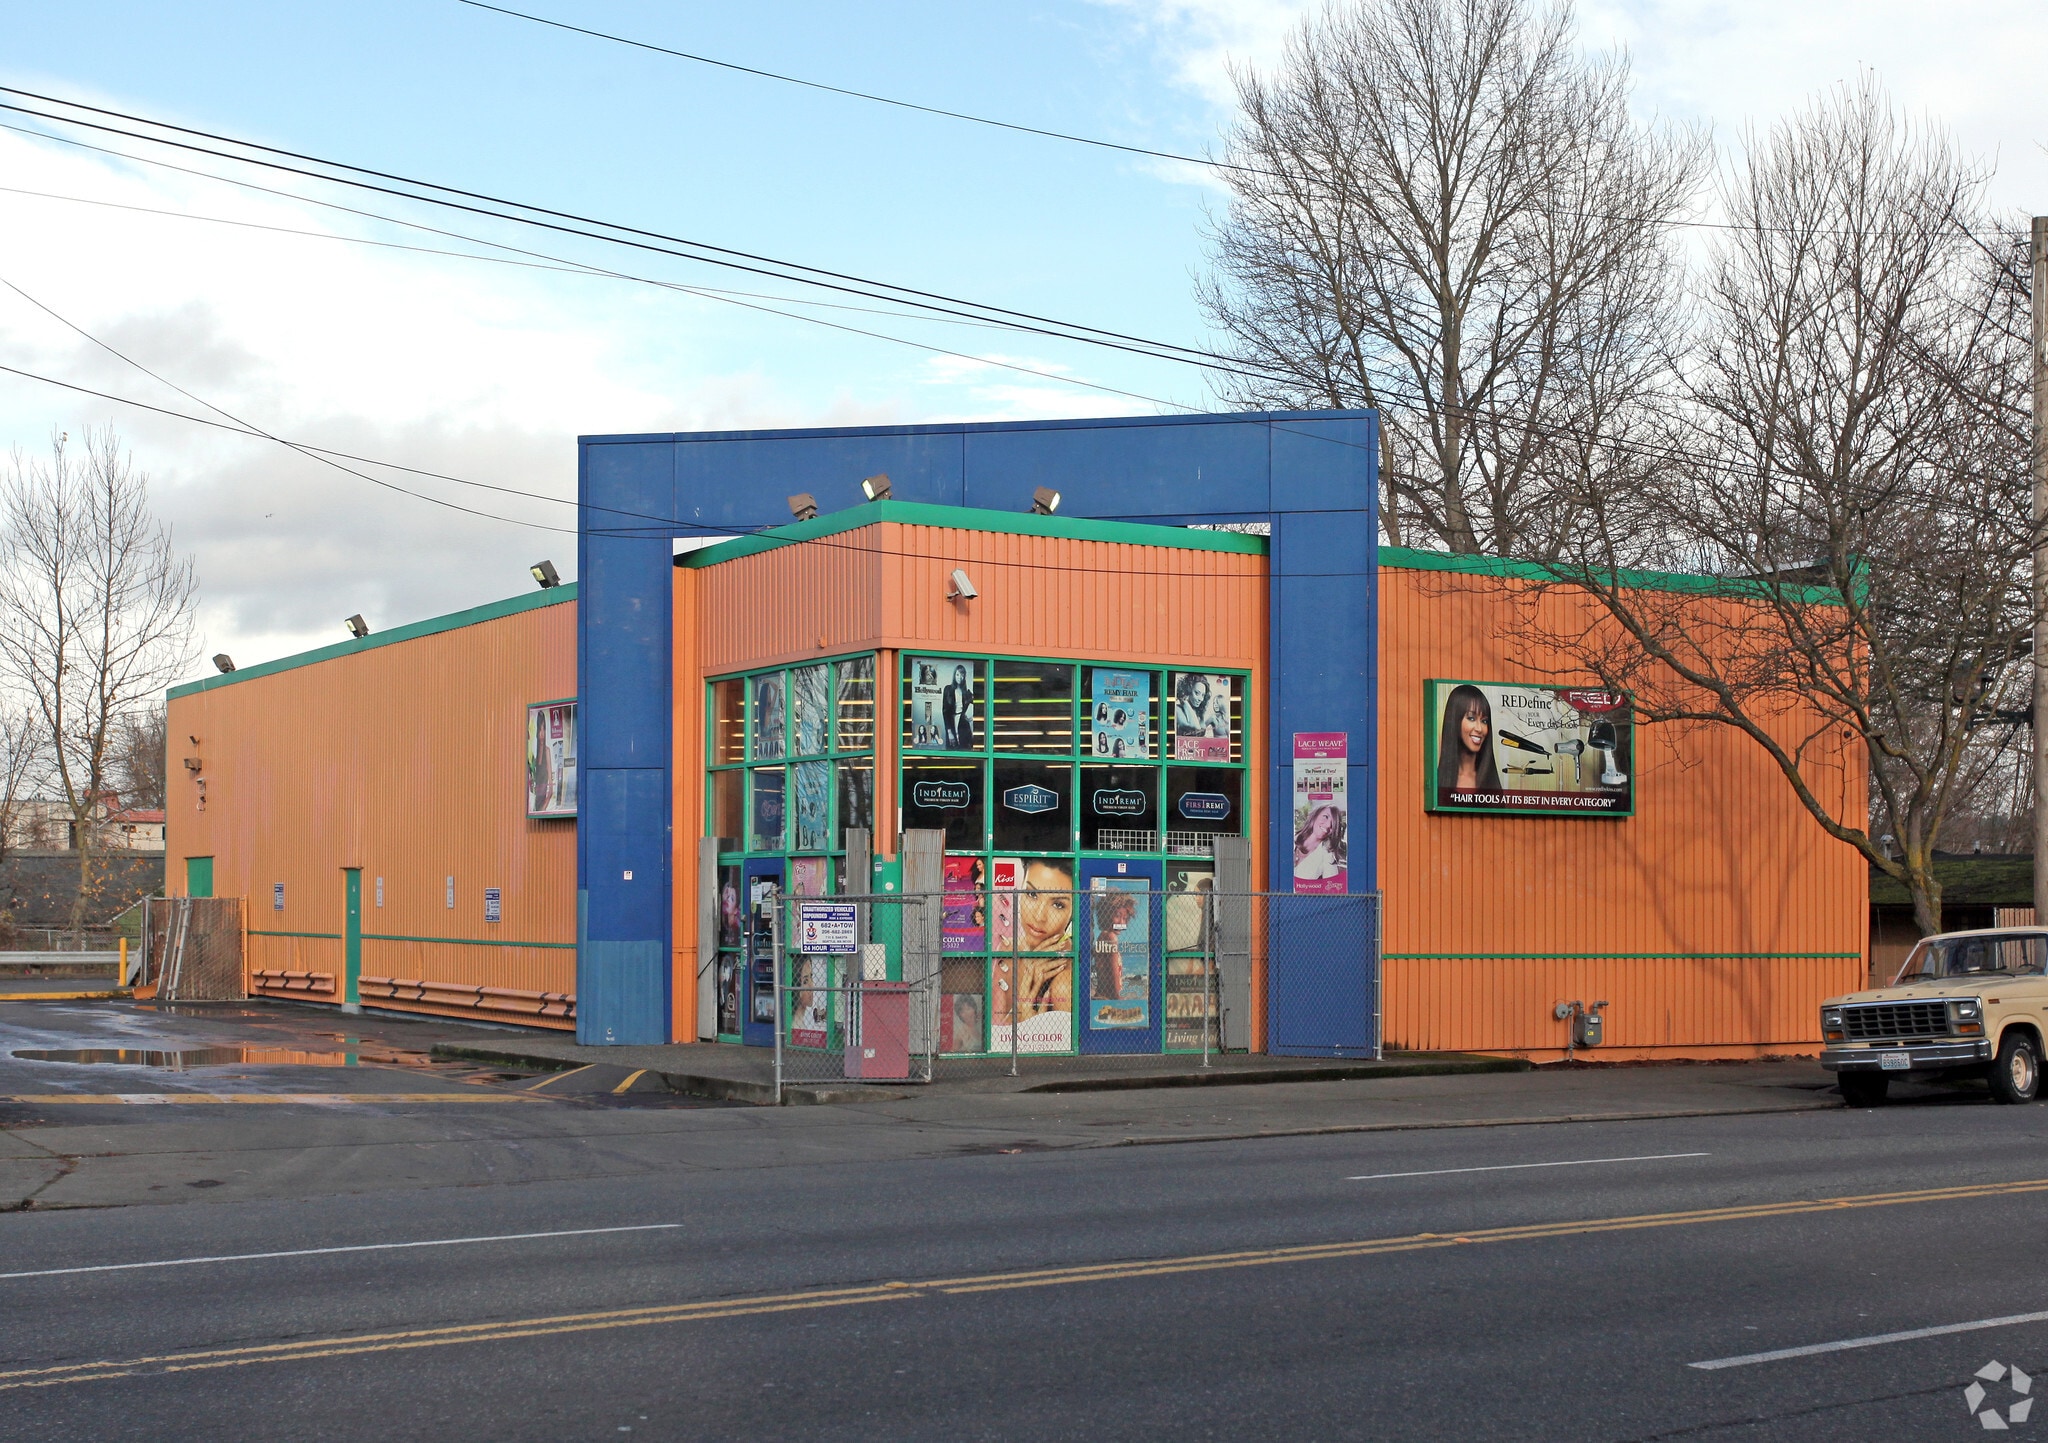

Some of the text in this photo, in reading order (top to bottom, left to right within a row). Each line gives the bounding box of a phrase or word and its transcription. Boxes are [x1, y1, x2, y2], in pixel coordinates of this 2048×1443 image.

[1501, 694, 1552, 709] REDefine
[1178, 740, 1200, 749] LACE
[1014, 792, 1048, 804] ESPIRIT
[1474, 794, 1500, 804] TOOLS
[1500, 795, 1511, 804] AT
[1512, 795, 1522, 804] ITS
[1524, 795, 1540, 805] BEST
[1541, 796, 1550, 805] IN
[1551, 797, 1573, 806] EVERY
[994, 873, 1014, 884] Kiss
[1095, 941, 1119, 954] Ultra
[1000, 1033, 1063, 1042] LIVNG COLOR
[1167, 1032, 1199, 1046] Living
